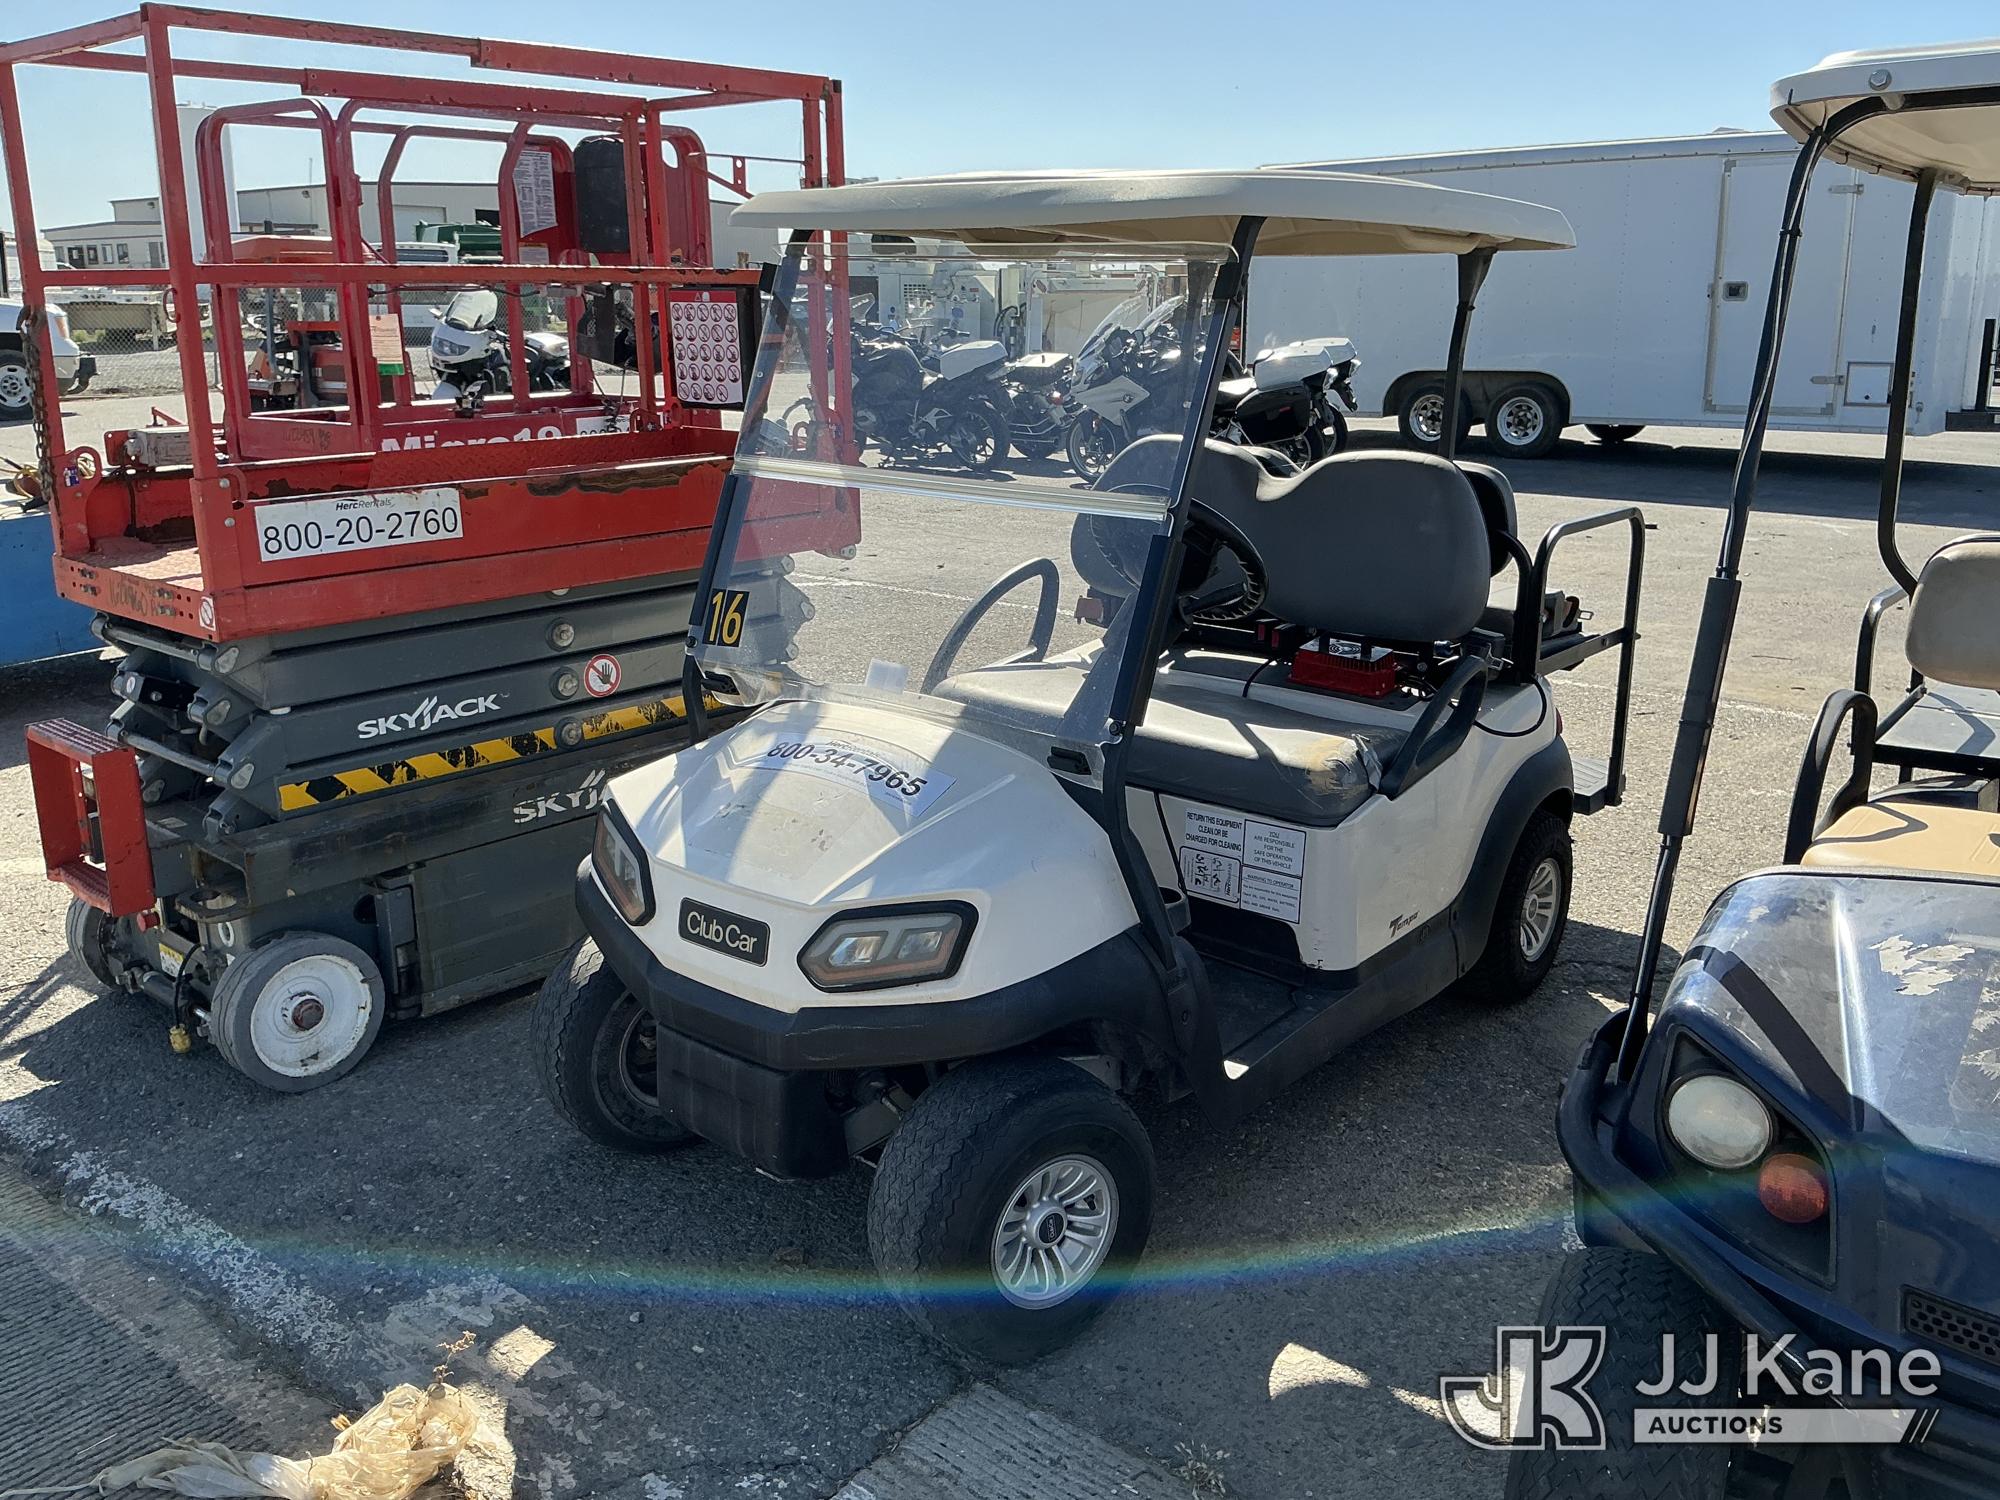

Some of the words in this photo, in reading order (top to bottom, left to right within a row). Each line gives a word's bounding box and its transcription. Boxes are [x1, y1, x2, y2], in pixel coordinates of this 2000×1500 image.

[263, 507, 458, 555] 800-20-2760
[709, 591, 744, 645] 16
[357, 694, 501, 739] SKYJACK
[767, 741, 928, 796] 800-34-7965
[1186, 833, 1207, 844] CHARGED
[1208, 837, 1218, 846] FOR
[1218, 840, 1241, 852] CLEANING
[1187, 811, 1205, 822] RETURN
[1205, 815, 1215, 825] THIS
[1216, 817, 1242, 830] EQUIPMENT
[1198, 825, 1213, 835] CLEAN
[1214, 828, 1221, 836] OR
[1222, 830, 1228, 838] BE
[687, 911, 724, 943] Club
[725, 924, 758, 954] Car
